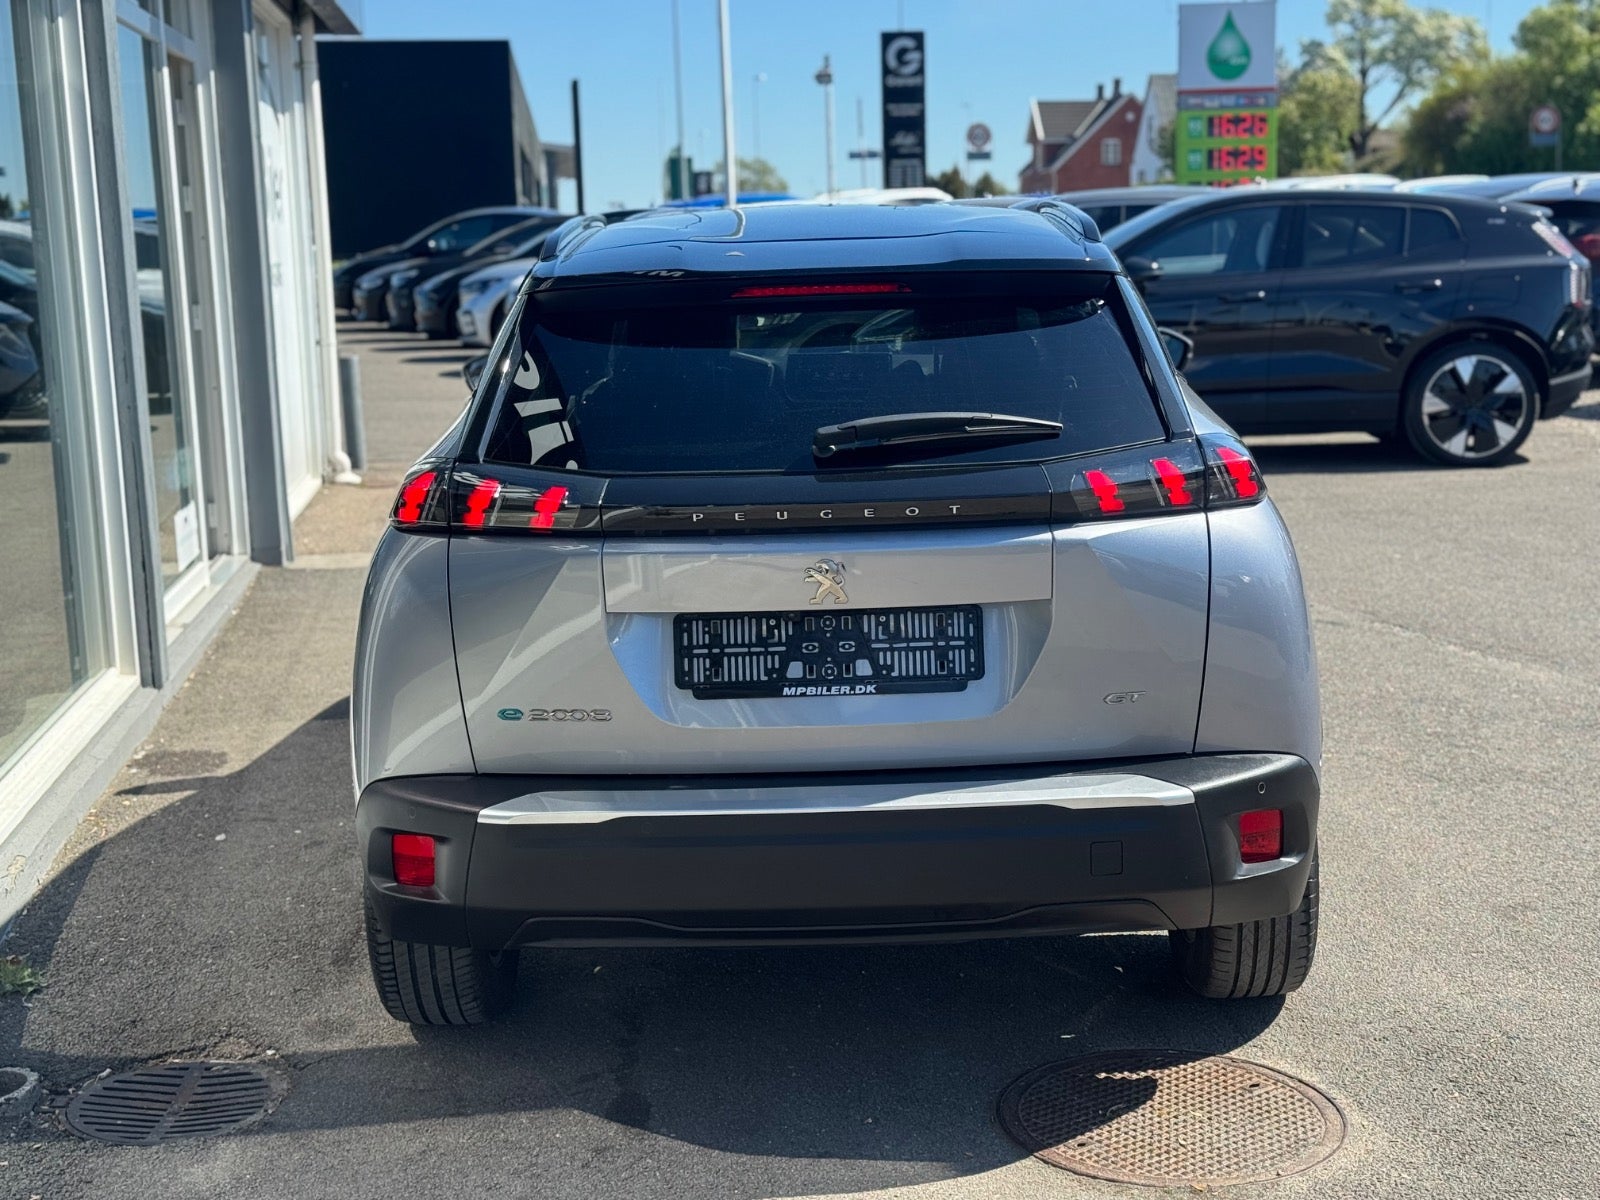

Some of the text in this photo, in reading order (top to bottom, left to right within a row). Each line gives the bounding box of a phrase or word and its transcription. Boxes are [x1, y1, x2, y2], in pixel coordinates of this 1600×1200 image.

[692, 504, 961, 522] PEUGEOT
[782, 683, 878, 697] MPBILER.DK
[1103, 690, 1147, 704] GT
